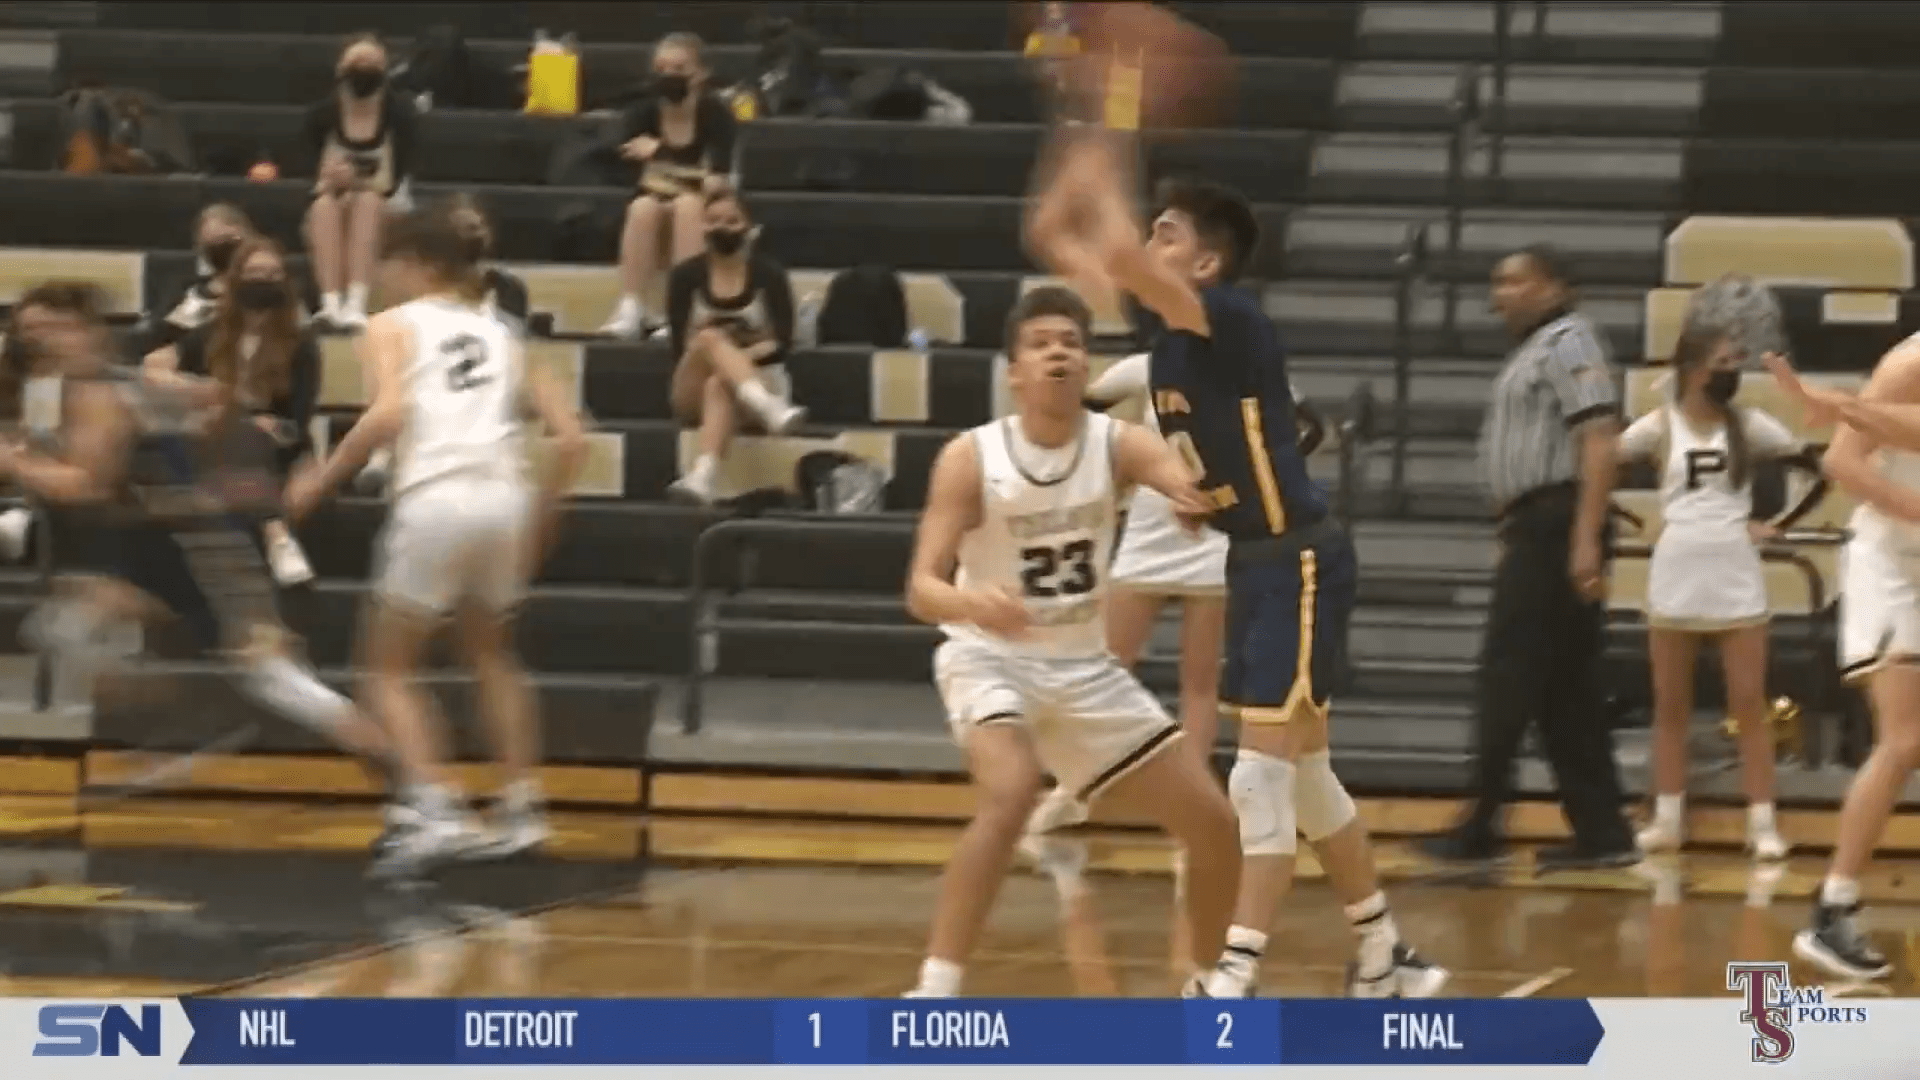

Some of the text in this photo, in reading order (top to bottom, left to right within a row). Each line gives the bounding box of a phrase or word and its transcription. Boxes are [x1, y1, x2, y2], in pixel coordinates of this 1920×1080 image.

[440, 331, 494, 392] 2
[1686, 450, 1728, 488] P
[1021, 540, 1097, 597] 23
